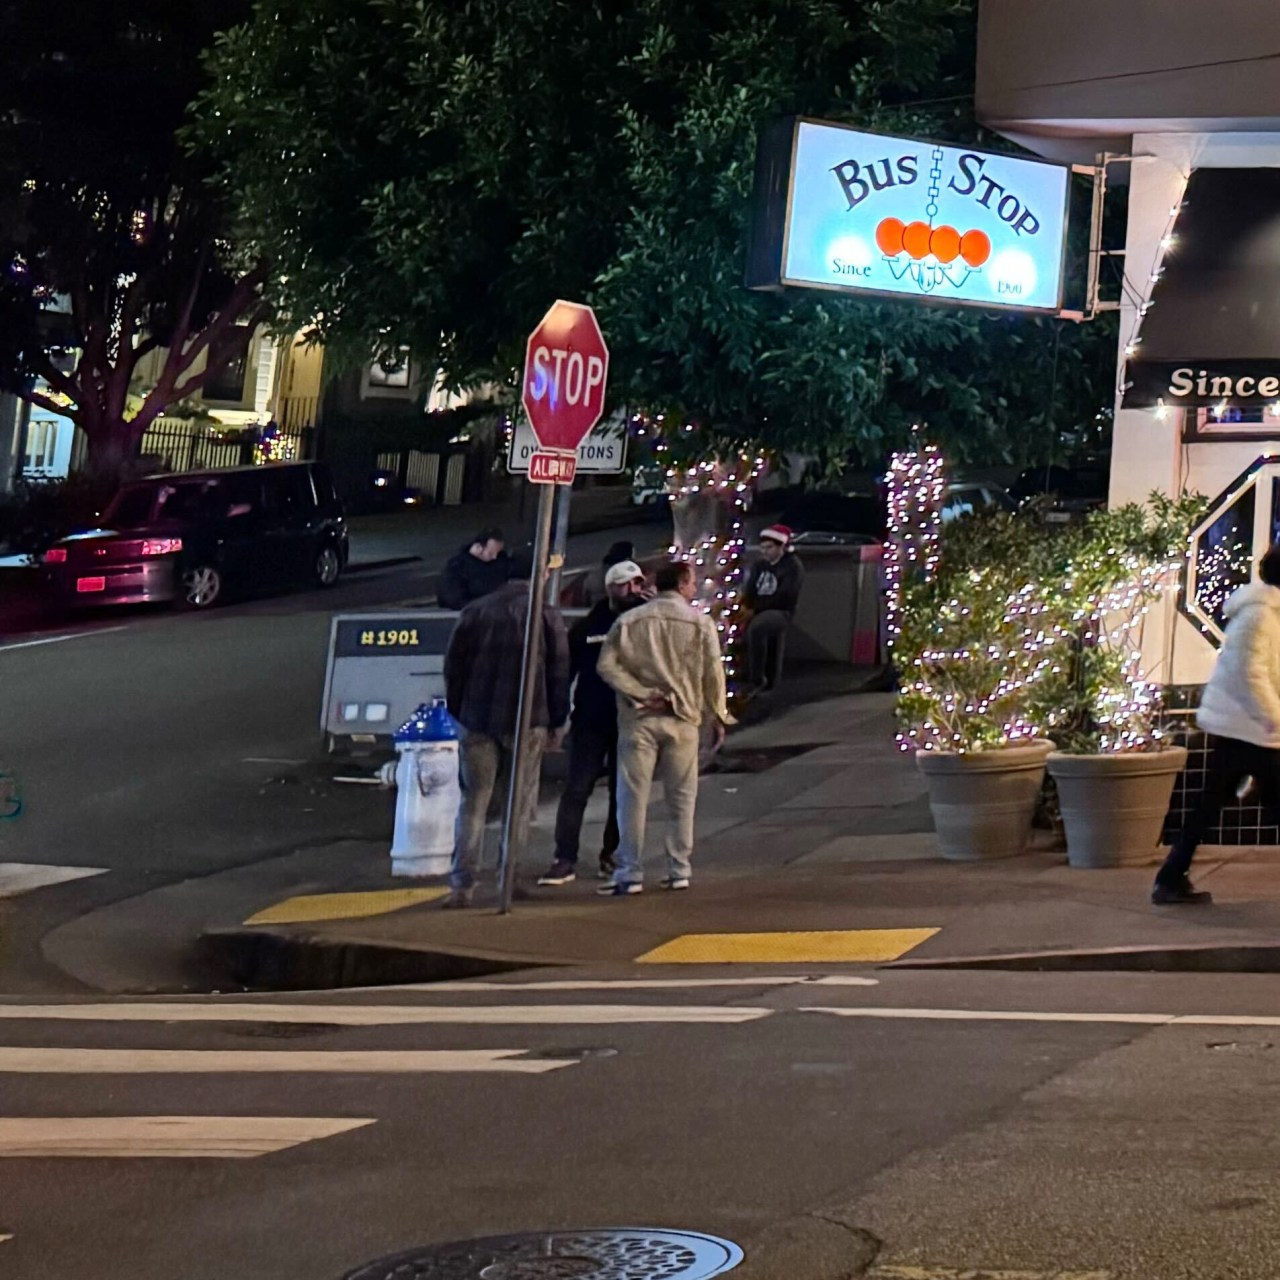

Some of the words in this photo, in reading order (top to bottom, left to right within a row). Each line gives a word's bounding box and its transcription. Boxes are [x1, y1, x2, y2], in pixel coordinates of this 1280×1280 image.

[829, 154, 918, 212] Bus
[530, 345, 604, 410] STOP
[1168, 367, 1280, 397] Since
[580, 446, 614, 460] TONS
